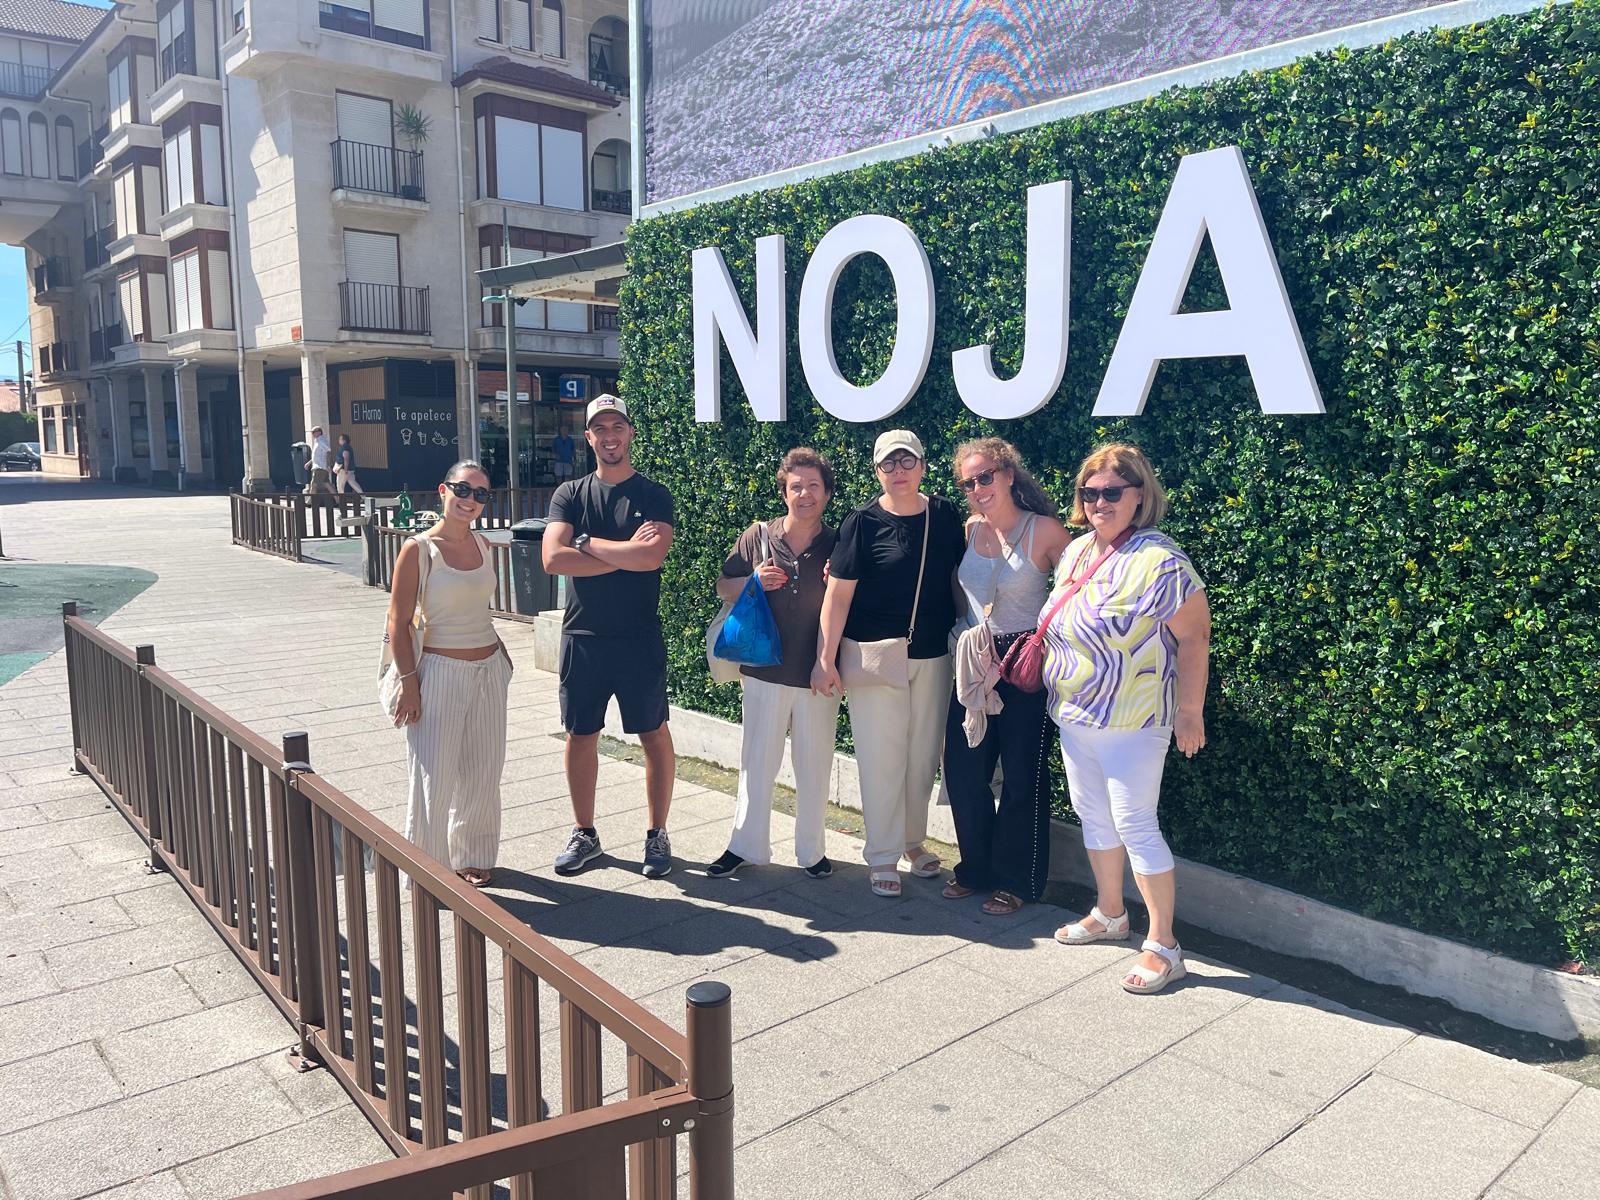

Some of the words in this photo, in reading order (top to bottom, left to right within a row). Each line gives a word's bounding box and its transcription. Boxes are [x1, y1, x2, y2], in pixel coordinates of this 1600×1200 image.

[692, 145, 1326, 423] NOJA
[353, 403, 360, 421] El
[362, 402, 381, 421] Horno
[394, 406, 407, 421] Te
[410, 408, 452, 426] apetece
